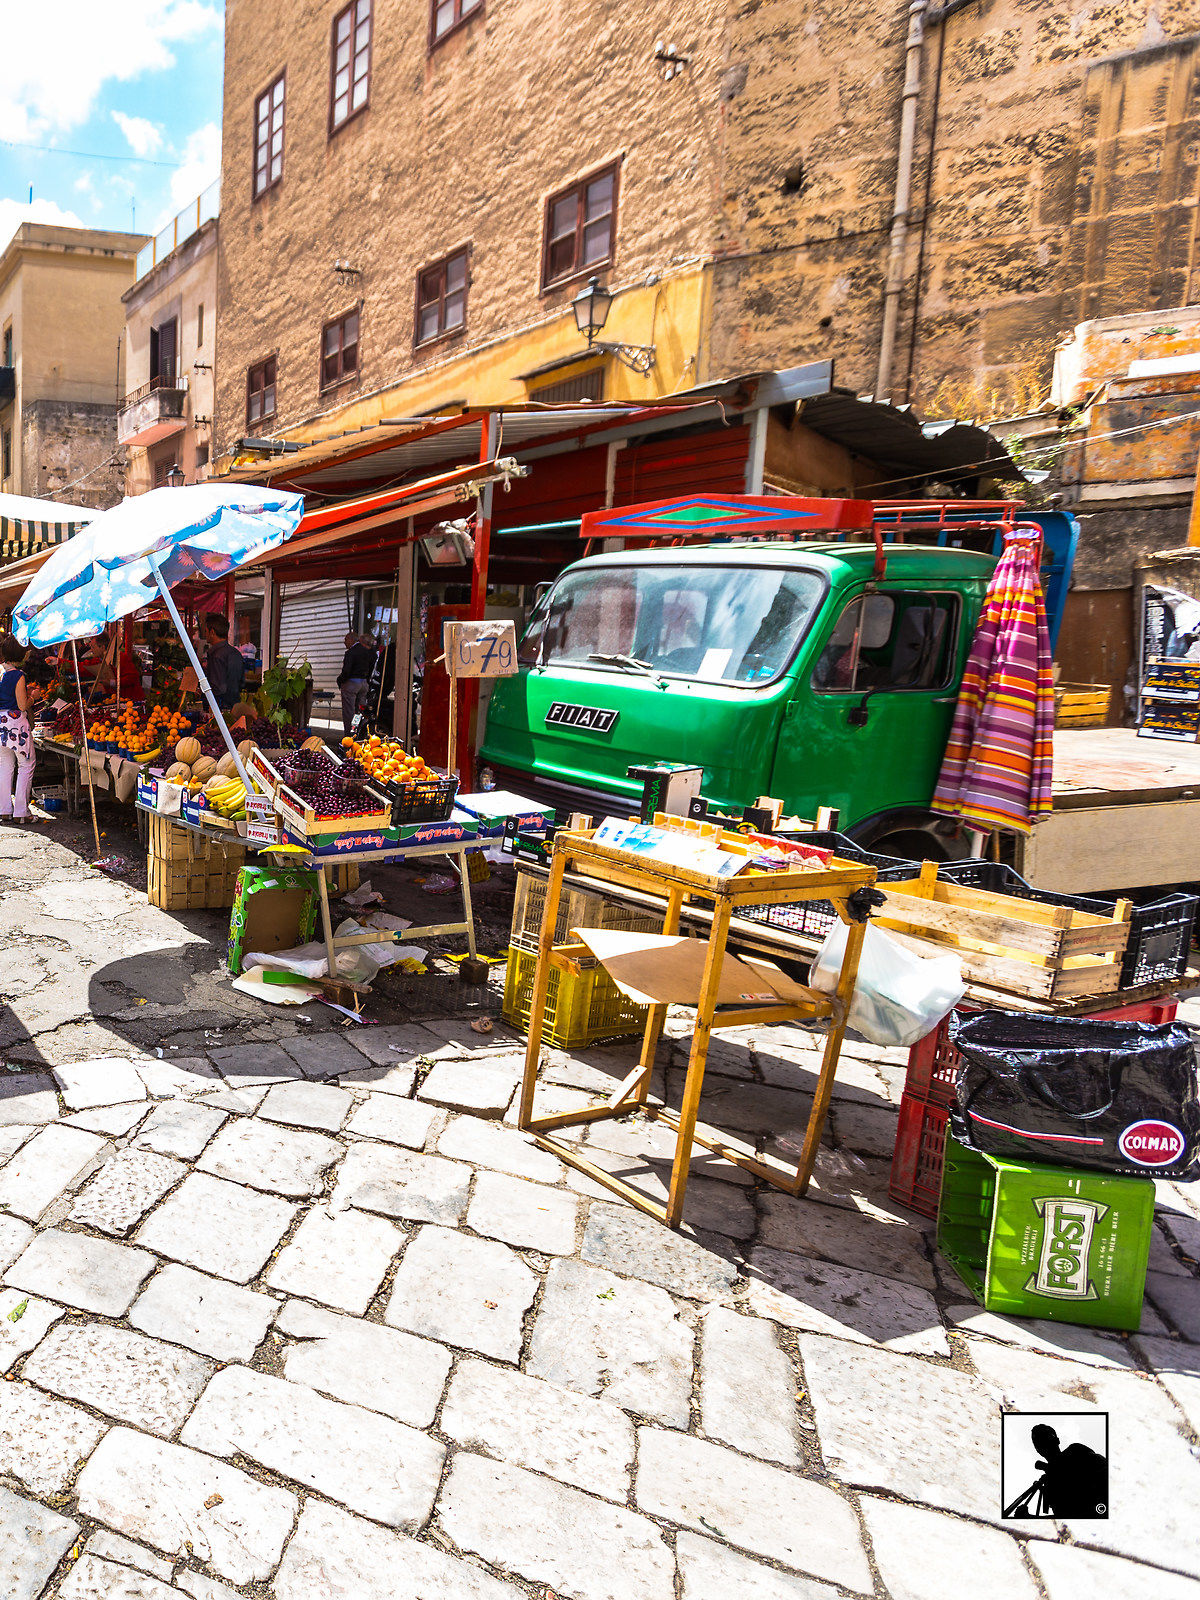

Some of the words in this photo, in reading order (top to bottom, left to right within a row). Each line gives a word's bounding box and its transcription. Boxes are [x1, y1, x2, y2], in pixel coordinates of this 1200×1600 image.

[459, 638, 512, 673] 0.79
[551, 705, 611, 727] FIAT
[1125, 1136, 1179, 1151] COLMAR
[1047, 1206, 1085, 1290] FORST
[1104, 1275, 1112, 1296] BIRRA
